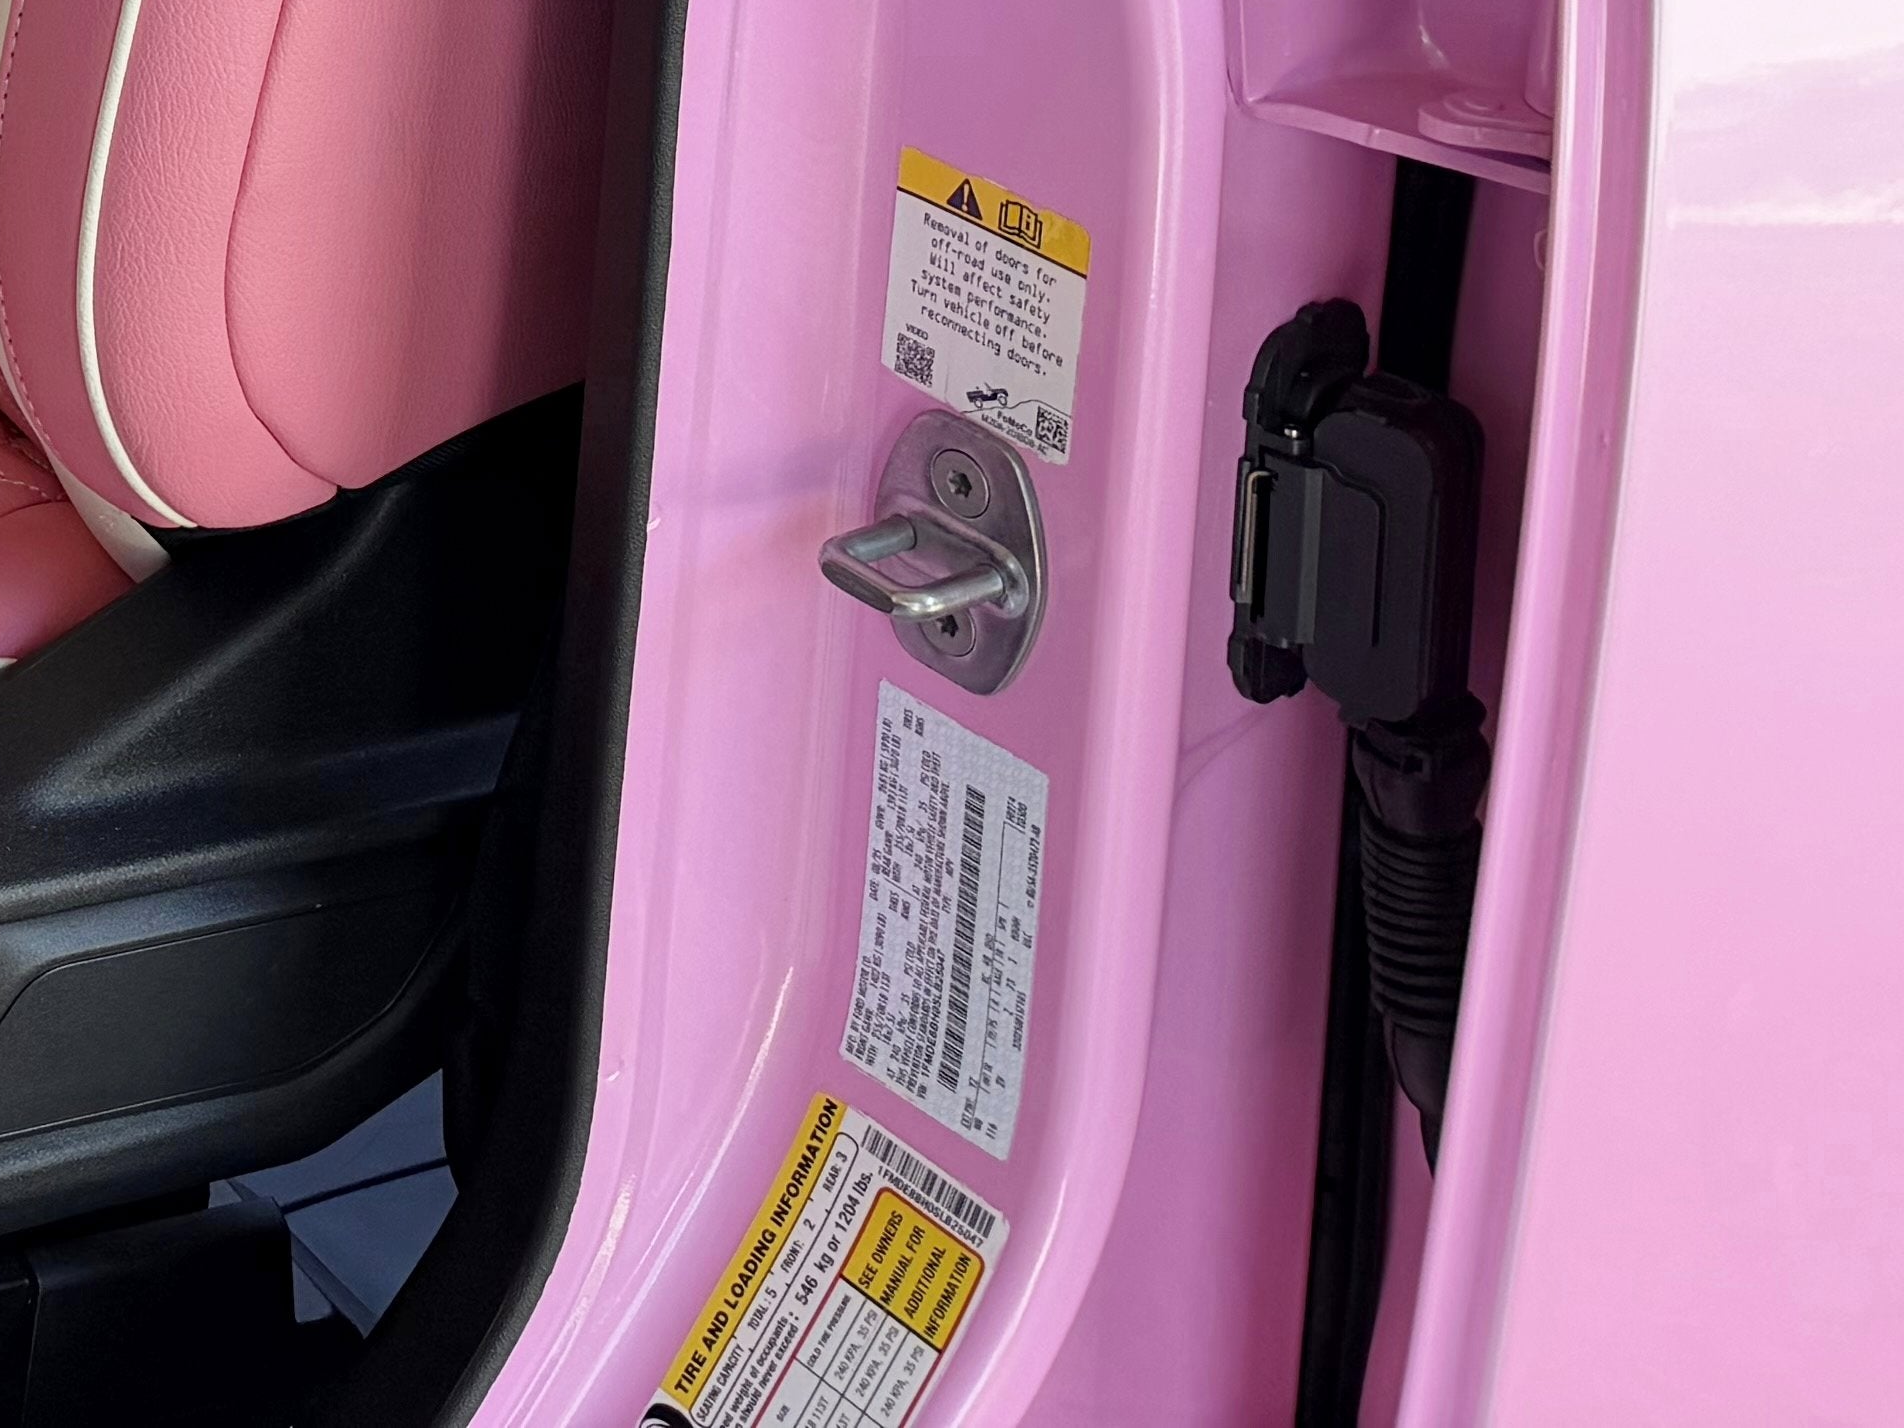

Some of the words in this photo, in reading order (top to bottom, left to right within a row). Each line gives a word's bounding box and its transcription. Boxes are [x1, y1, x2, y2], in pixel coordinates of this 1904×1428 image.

[924, 212, 968, 246] Removal
[975, 241, 988, 253] of
[996, 250, 1028, 274] doors
[1037, 268, 1056, 286] for
[932, 238, 984, 271] off-road
[992, 268, 1011, 284] use
[1018, 280, 1050, 303] only.
[911, 279, 937, 303] Turn
[944, 298, 989, 330] vehicle
[995, 324, 1014, 341] off
[1022, 336, 1062, 367] before
[922, 270, 960, 297] system
[967, 292, 1046, 338] performance.
[930, 252, 954, 276] Will
[963, 272, 1002, 299] affect
[1010, 294, 1049, 324] safety
[921, 306, 1000, 356] reconnecting
[1007, 348, 1046, 376] doors.
[674, 1350, 706, 1393] TIRE
[702, 1311, 728, 1352] AND
[724, 1229, 776, 1310] LOADING
[770, 1098, 838, 1227] INFORMATION
[795, 1275, 818, 1305] 546
[814, 1253, 834, 1273] kg
[828, 1234, 840, 1252] or
[835, 1194, 860, 1232] 1204
[852, 1173, 873, 1196] lbs.
[858, 1263, 878, 1289] SEE
[872, 1210, 903, 1264] OWNERS
[880, 1255, 913, 1306] MANUAL
[906, 1226, 925, 1253] FOR
[697, 1385, 721, 1422] SEATING
[717, 1344, 744, 1386] CAPACITY
[765, 1287, 776, 1298] 5
[803, 1219, 815, 1230] 2
[836, 1151, 847, 1162] 3
[904, 1247, 946, 1319] ADDITIONAL
[924, 1252, 971, 1339] INFORMATION
[730, 1378, 753, 1413] weight
[750, 1365, 759, 1378] of
[756, 1317, 788, 1366] occupants
[740, 1388, 762, 1423] should
[759, 1360, 777, 1389] never
[775, 1323, 798, 1360] exceed
[834, 1362, 849, 1380] 240
[857, 1325, 869, 1339] 35
[864, 1310, 878, 1326] PSI
[856, 1378, 870, 1397] 240
[879, 1342, 890, 1356] 35
[886, 1326, 899, 1343] PSI
[881, 1398, 895, 1417] 240
[904, 1361, 915, 1376] 35
[910, 1346, 924, 1362] PSI
